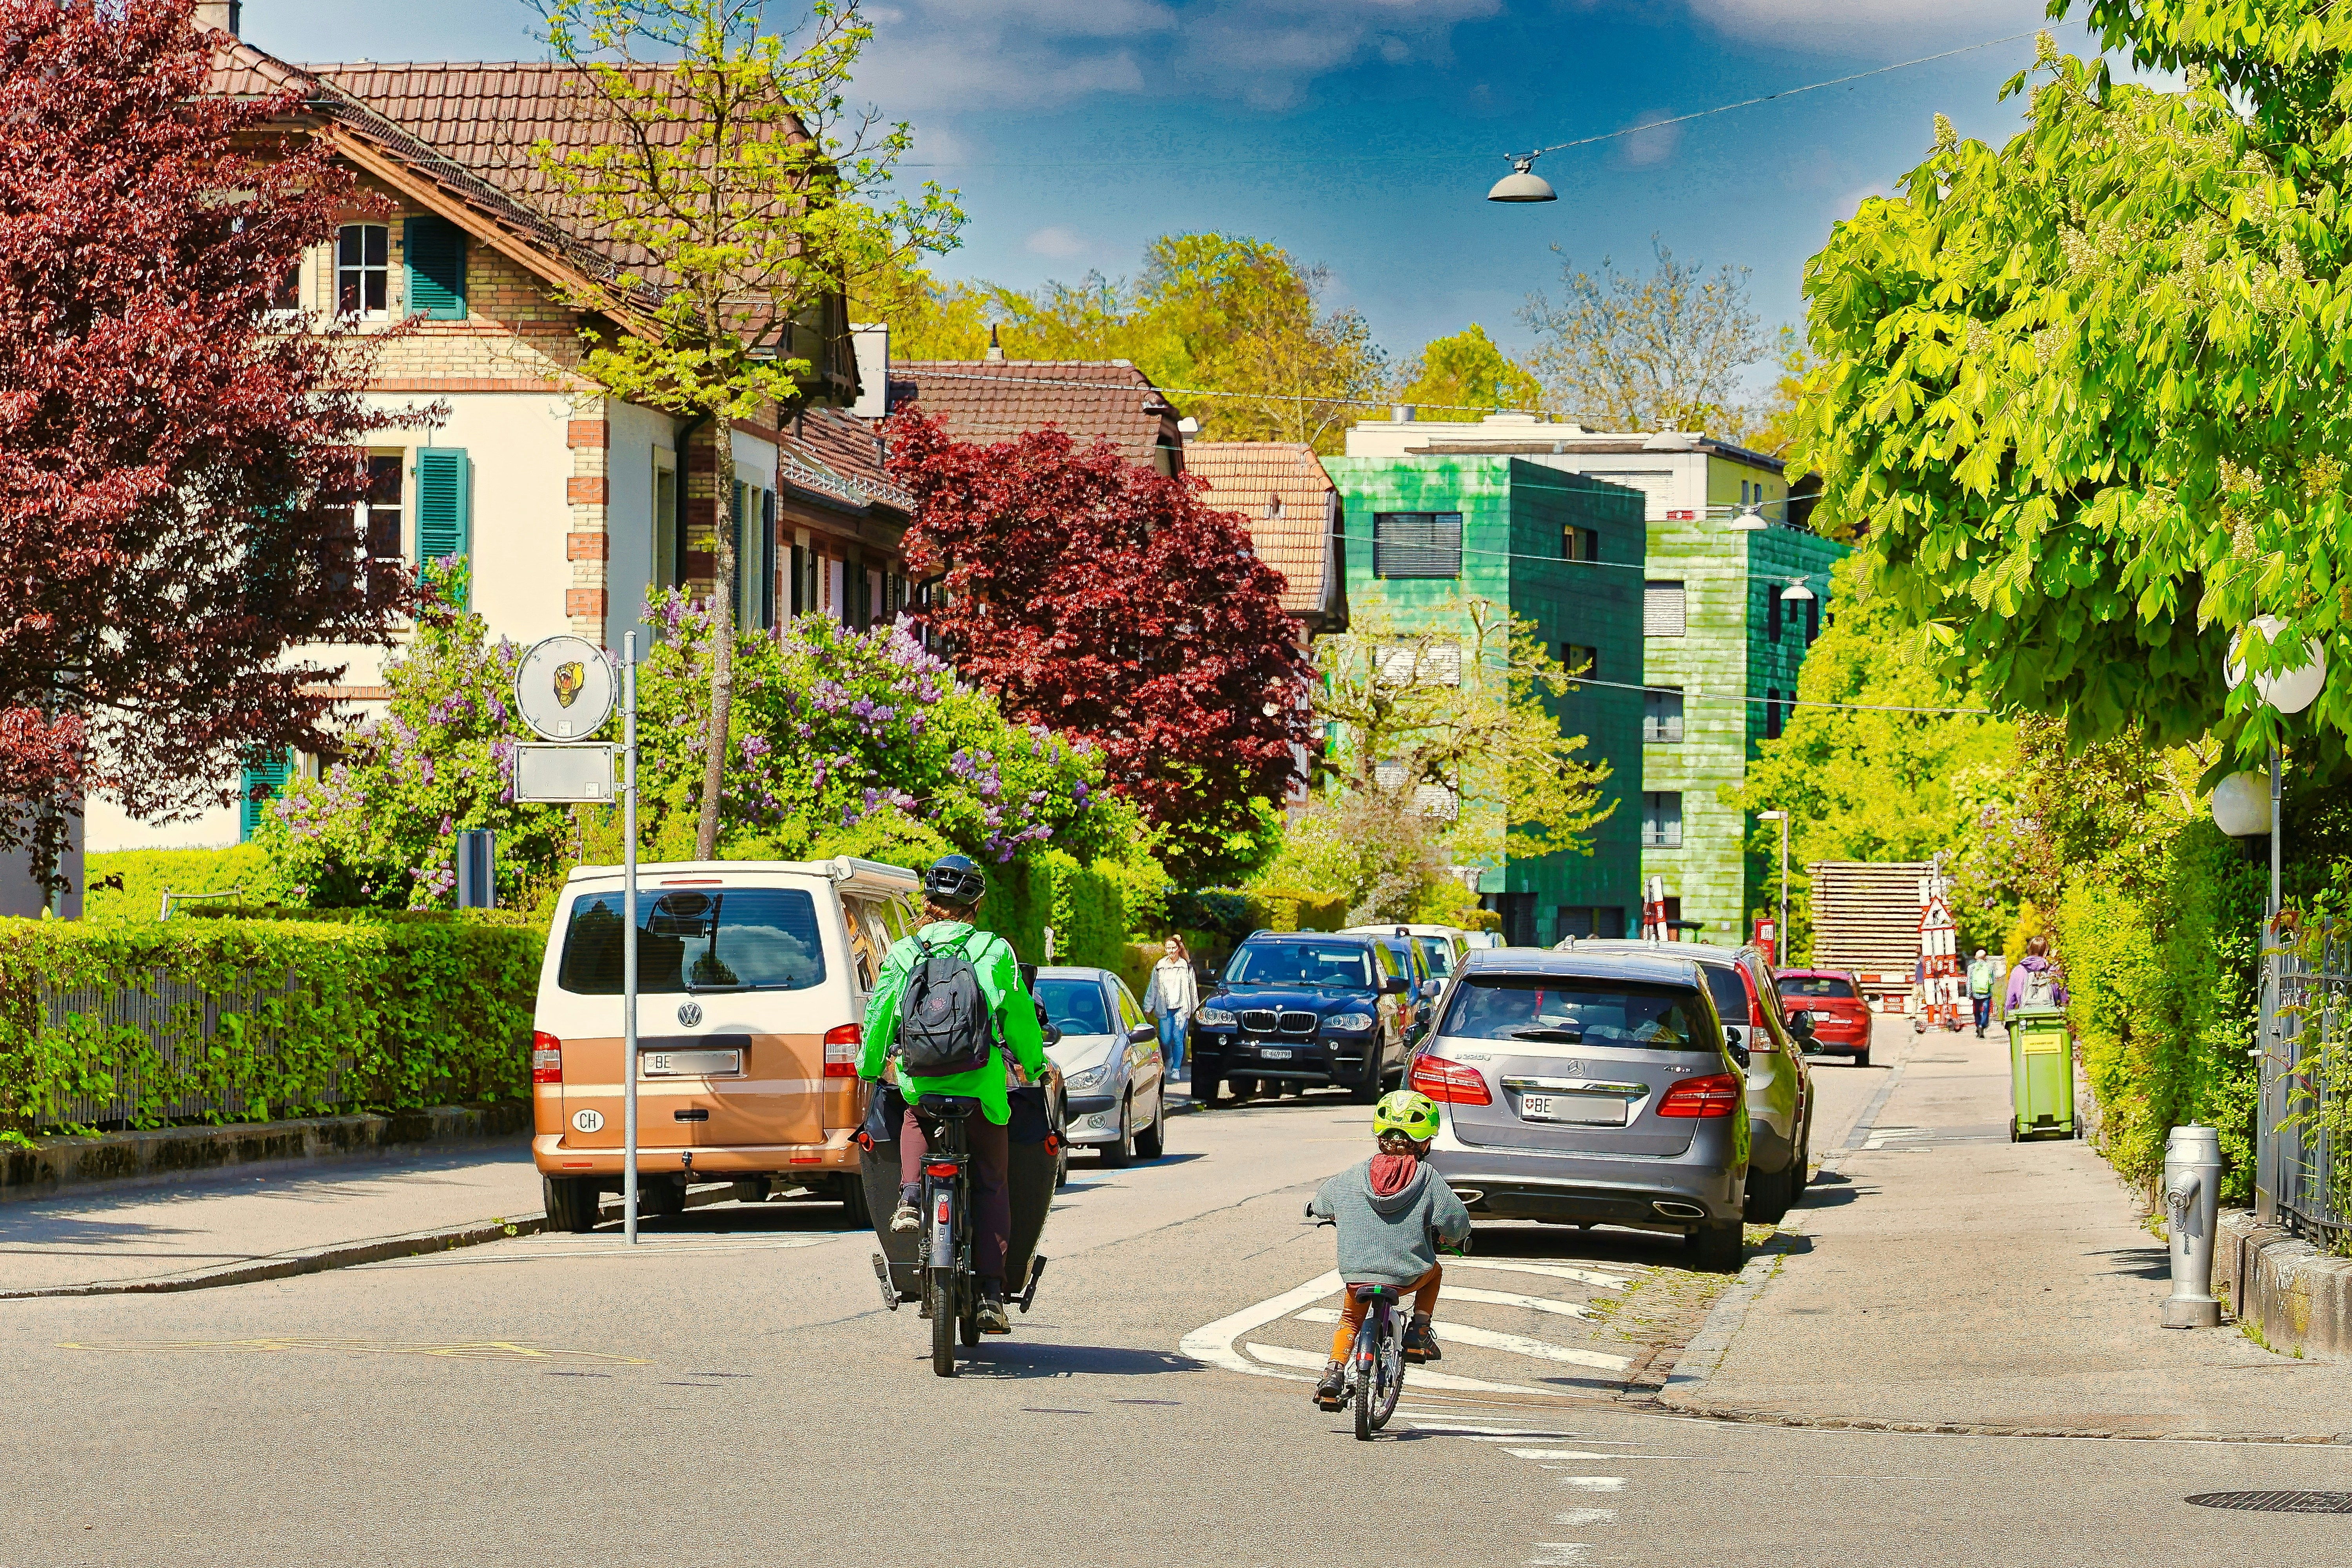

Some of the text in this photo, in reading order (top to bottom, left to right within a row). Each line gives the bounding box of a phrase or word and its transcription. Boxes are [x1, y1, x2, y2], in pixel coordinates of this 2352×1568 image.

[656, 1055, 671, 1069] BE
[1535, 1098, 1552, 1113] BE
[579, 1113, 596, 1129] CH
